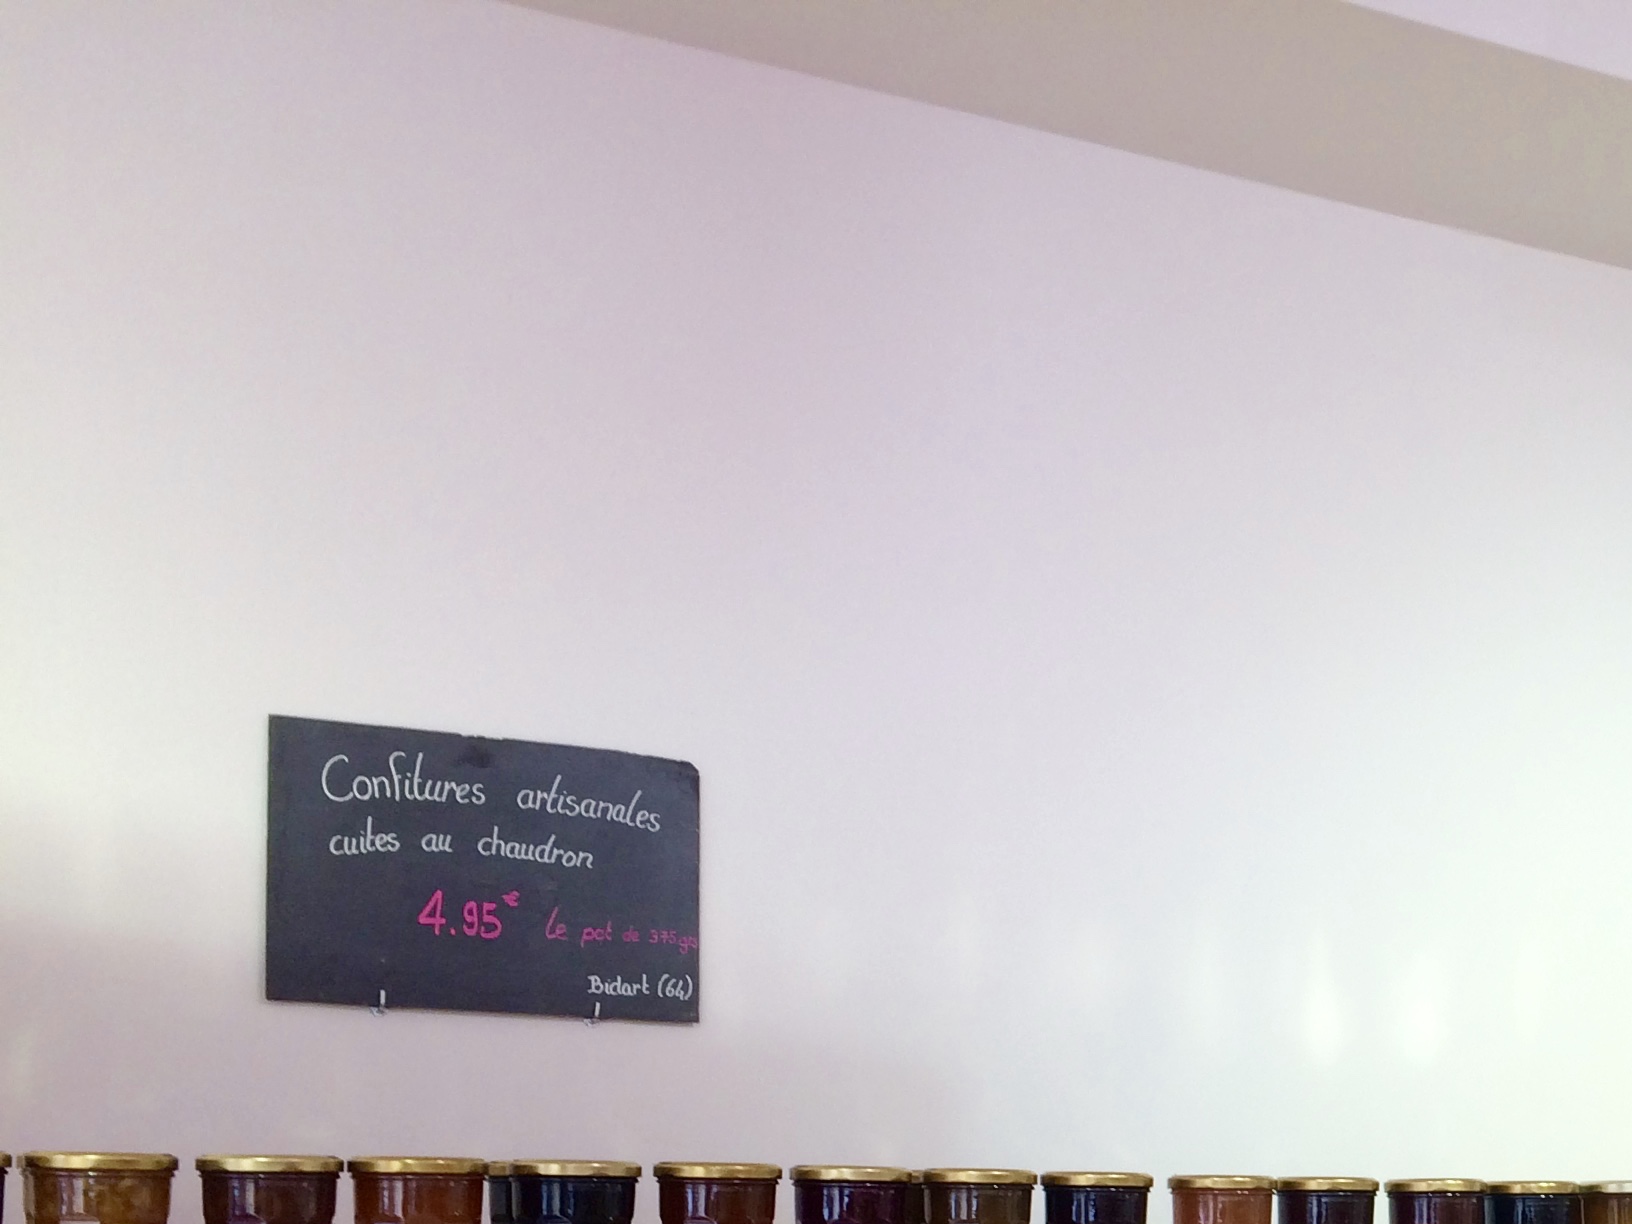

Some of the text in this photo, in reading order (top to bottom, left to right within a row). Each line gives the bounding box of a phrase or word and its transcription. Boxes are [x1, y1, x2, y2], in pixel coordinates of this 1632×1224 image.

[321, 750, 661, 832] Confitures artisanales
[329, 815, 594, 869] cuites au chaudron
[580, 920, 612, 947] pot
[622, 925, 640, 942] de
[586, 974, 693, 1000] Bidart (64)
